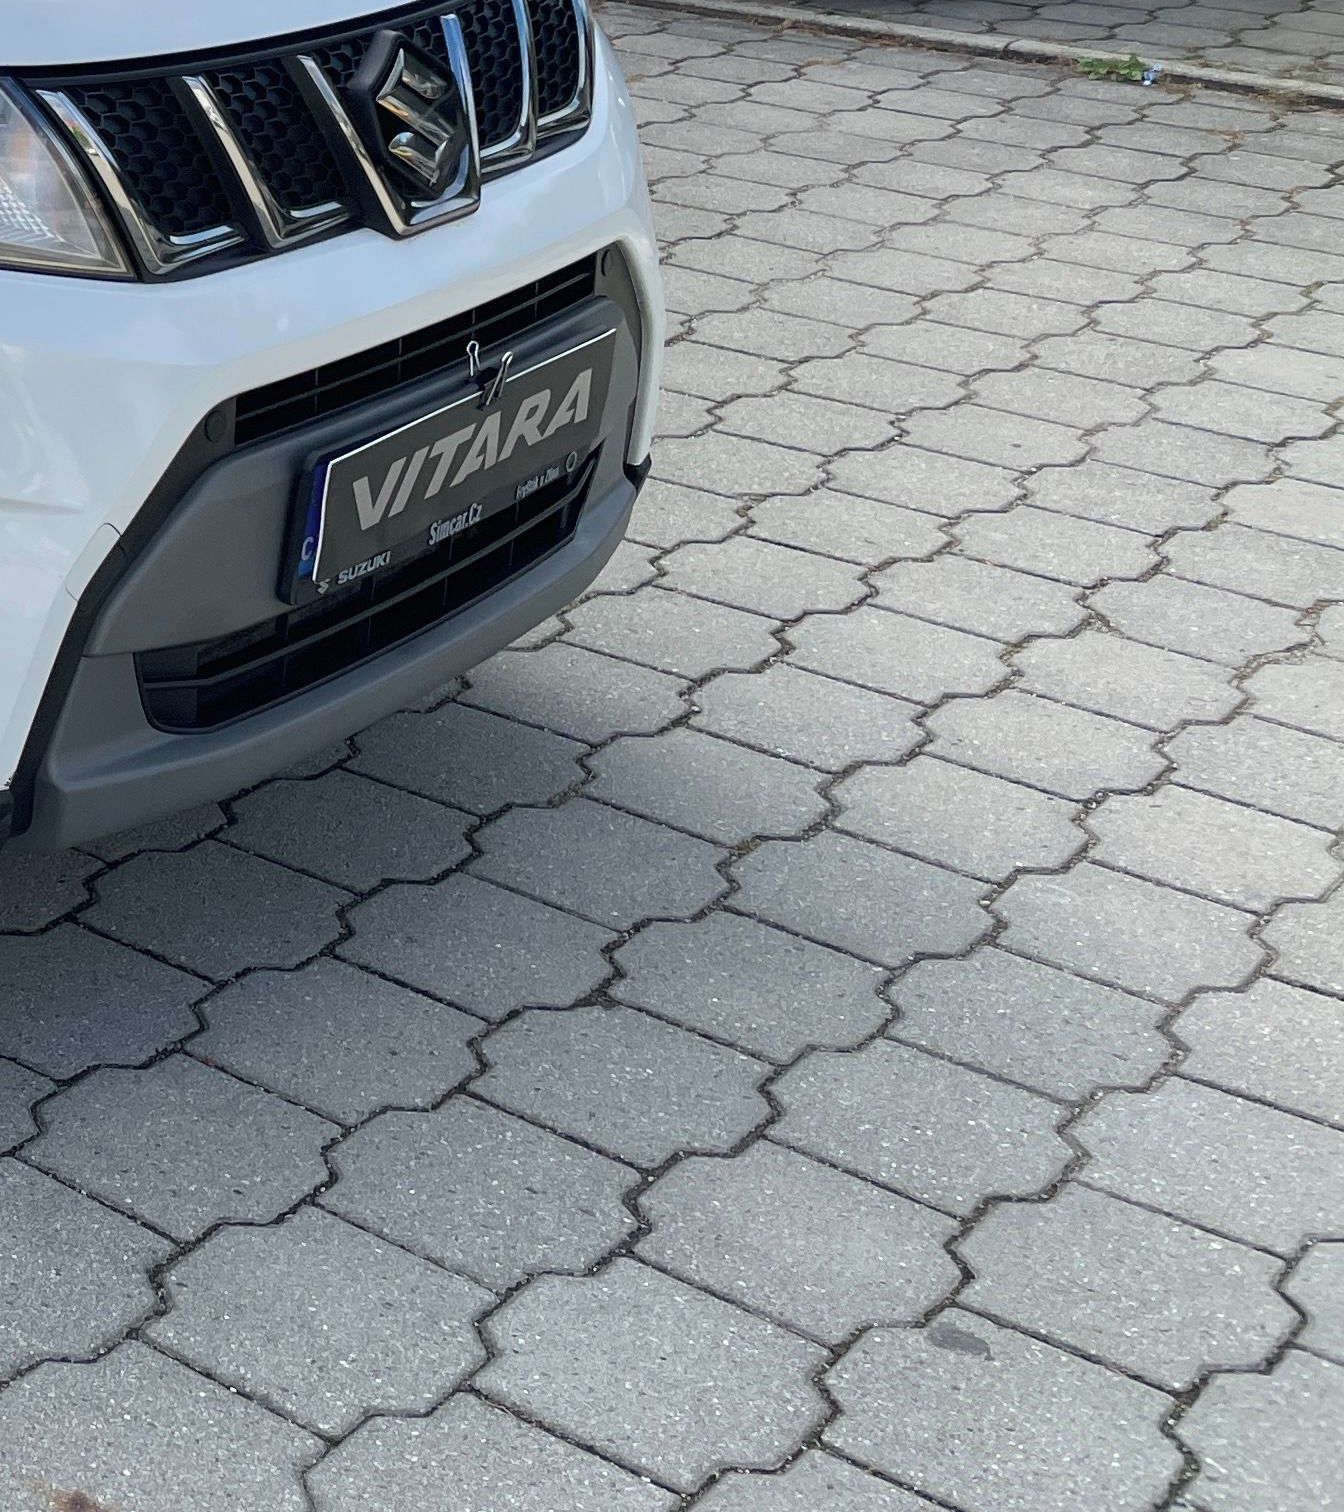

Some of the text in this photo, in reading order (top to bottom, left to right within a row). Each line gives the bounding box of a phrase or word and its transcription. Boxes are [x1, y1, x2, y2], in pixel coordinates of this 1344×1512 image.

[353, 368, 593, 531] VITARA
[301, 536, 314, 561] C
[337, 550, 392, 585] SUZUKI
